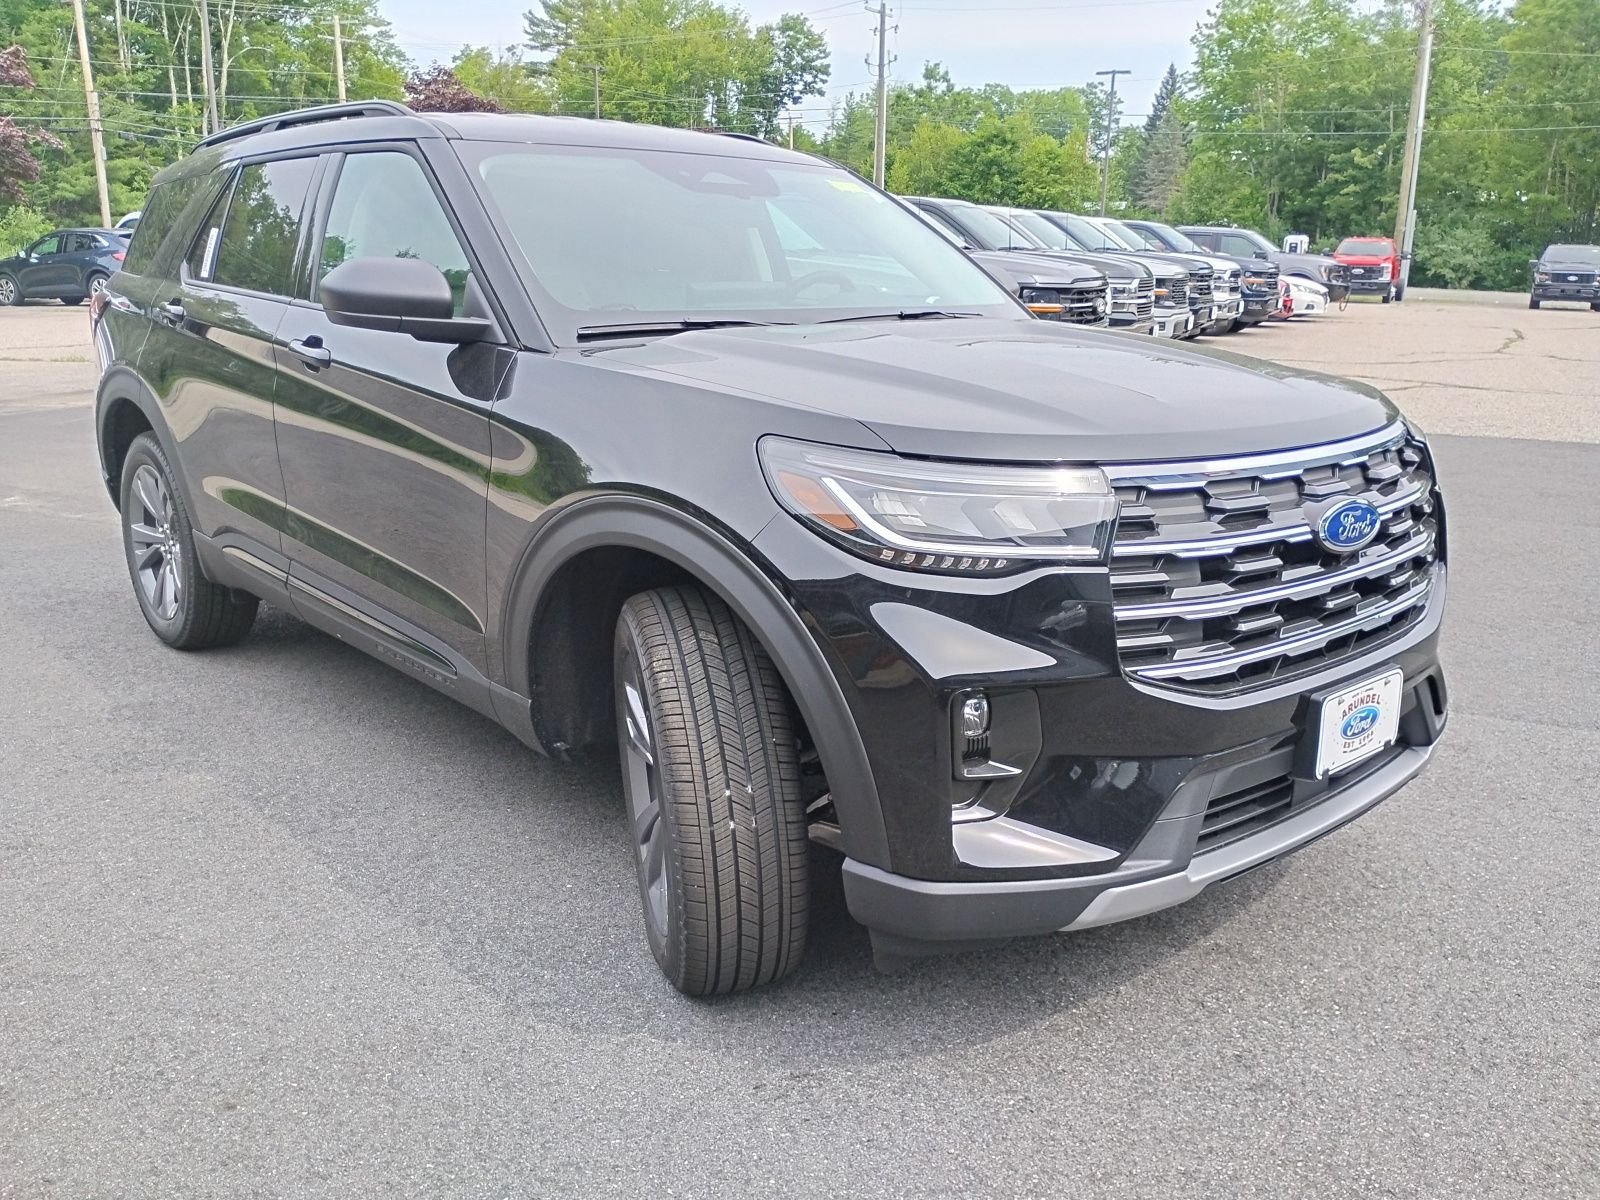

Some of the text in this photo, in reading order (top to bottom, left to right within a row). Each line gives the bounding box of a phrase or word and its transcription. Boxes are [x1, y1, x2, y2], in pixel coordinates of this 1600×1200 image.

[1338, 509, 1372, 541] Ford
[1341, 693, 1381, 721] ARUNDEL
[1346, 710, 1374, 737] Ford
